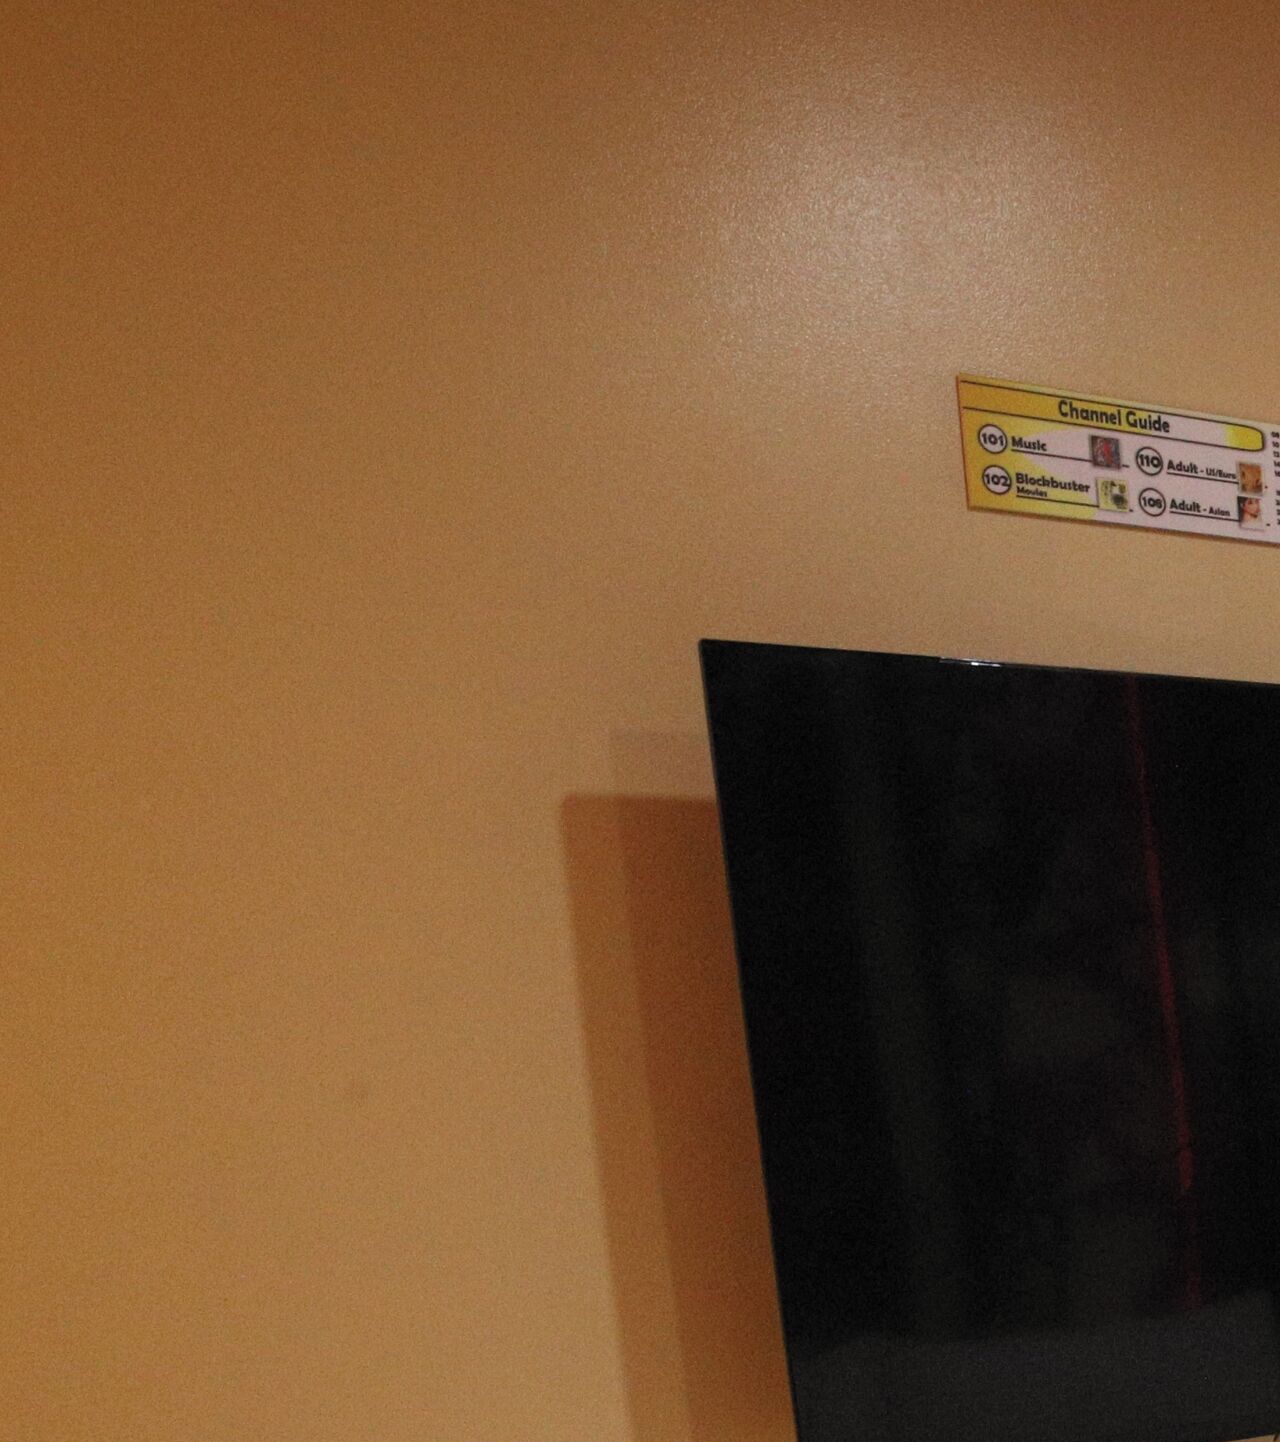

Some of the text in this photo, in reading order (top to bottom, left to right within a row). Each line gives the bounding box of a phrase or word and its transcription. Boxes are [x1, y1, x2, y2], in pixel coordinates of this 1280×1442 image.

[1058, 399, 1170, 433] Channel Guide
[981, 433, 1047, 452] 101 Music
[1139, 454, 1161, 468] 110
[1167, 459, 1199, 474] Adult
[985, 472, 1091, 493] 102 Blockbuster
[1016, 486, 1048, 498] Movies
[1169, 498, 1201, 513] Adult
[1208, 507, 1231, 517] Asian
